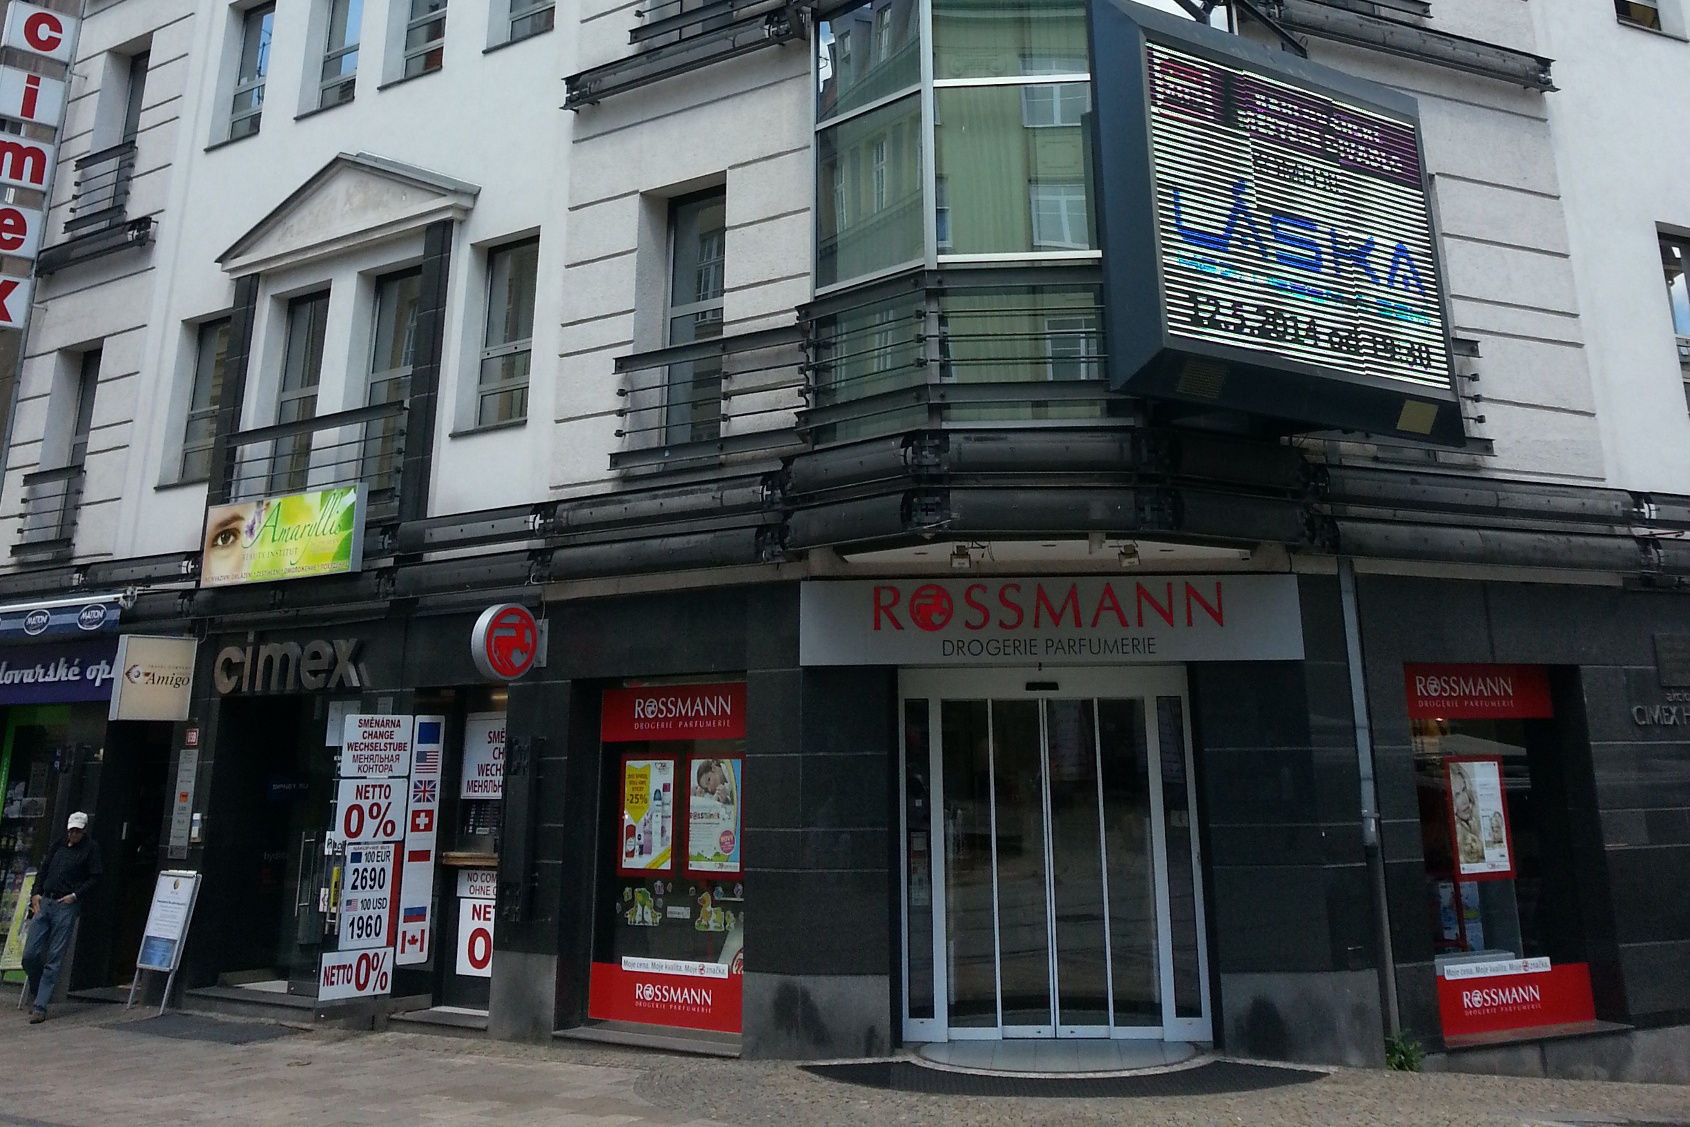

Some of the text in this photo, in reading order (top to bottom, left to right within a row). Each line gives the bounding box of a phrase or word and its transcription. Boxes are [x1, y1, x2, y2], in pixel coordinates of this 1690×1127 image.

[241, 490, 342, 566] Amaryllis
[267, 548, 298, 558] INSTITUT
[872, 580, 1224, 632] ROSSMANN
[941, 637, 1157, 657] DROGERIE PARFUMERIE
[214, 631, 361, 694] cimex
[145, 672, 190, 689] Amigo
[1415, 675, 1513, 697] ROSSMANN
[634, 695, 731, 719] ROSSMANN
[1418, 699, 1514, 708] DROGERIE PARFUMERIE
[358, 717, 401, 729] SMĚNÁRNA
[1632, 705, 1680, 725] CIMEX
[634, 719, 731, 730] DROGERIE PARFUMERIE
[362, 730, 394, 740] CHANGE
[347, 742, 408, 752] WECHSELSTUBE
[352, 754, 400, 763] МЕНЯЛЬНАЯ
[357, 764, 393, 774] КОНТОРА
[477, 763, 504, 777] WECH
[355, 784, 392, 800] NETTO
[343, 801, 396, 839] 0%
[364, 850, 391, 863] 100 EUR
[350, 867, 386, 891] 2690
[467, 872, 479, 883] NO
[469, 884, 491, 896] OHNE
[360, 897, 388, 911] 100 USD
[471, 903, 496, 922] NE
[349, 914, 382, 940] 1960
[322, 951, 389, 992] NETTO 0%
[623, 959, 636, 968] Moje
[651, 961, 664, 971] Moje
[684, 964, 698, 973] Moje
[635, 983, 712, 1006] ROSSMANN
[1463, 985, 1541, 1009] ROSSMANN
[635, 1001, 712, 1014] DROGERIE PARFUMERIE
